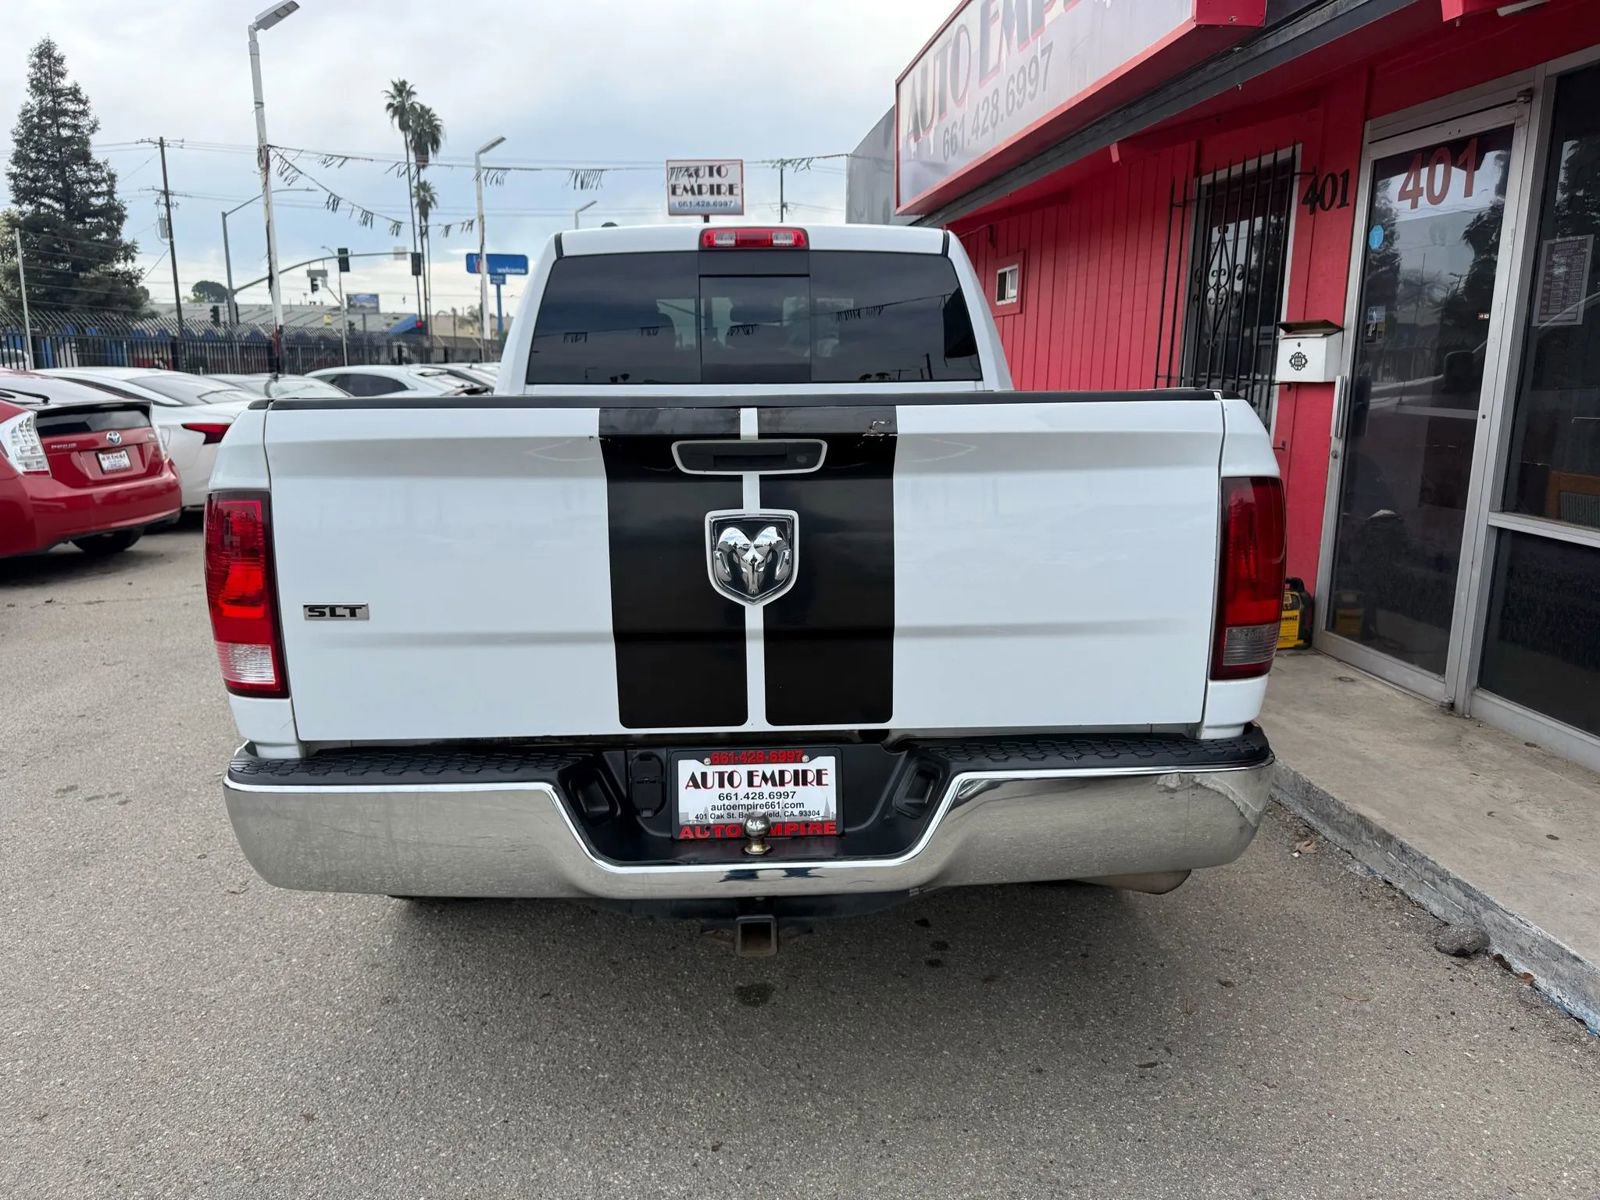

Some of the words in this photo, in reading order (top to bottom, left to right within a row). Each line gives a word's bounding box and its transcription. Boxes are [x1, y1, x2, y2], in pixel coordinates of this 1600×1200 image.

[905, 22, 971, 143] AUTO
[941, 40, 1054, 162] 661.428.6997
[1398, 136, 1480, 210] 401
[670, 183, 739, 197] EMPIRE
[1302, 169, 1351, 215] 401
[307, 606, 363, 618] SLT
[710, 751, 803, 764] 661-428-6997
[685, 769, 742, 790] AUTO
[746, 768, 829, 789] EMPIRE
[718, 791, 797, 801] 661.428.6997
[709, 812, 725, 820] Oak
[798, 809, 821, 817] 93304
[710, 801, 805, 812] autoempire661.com
[679, 824, 742, 839] AUTO
[769, 821, 837, 836] MPIRE
